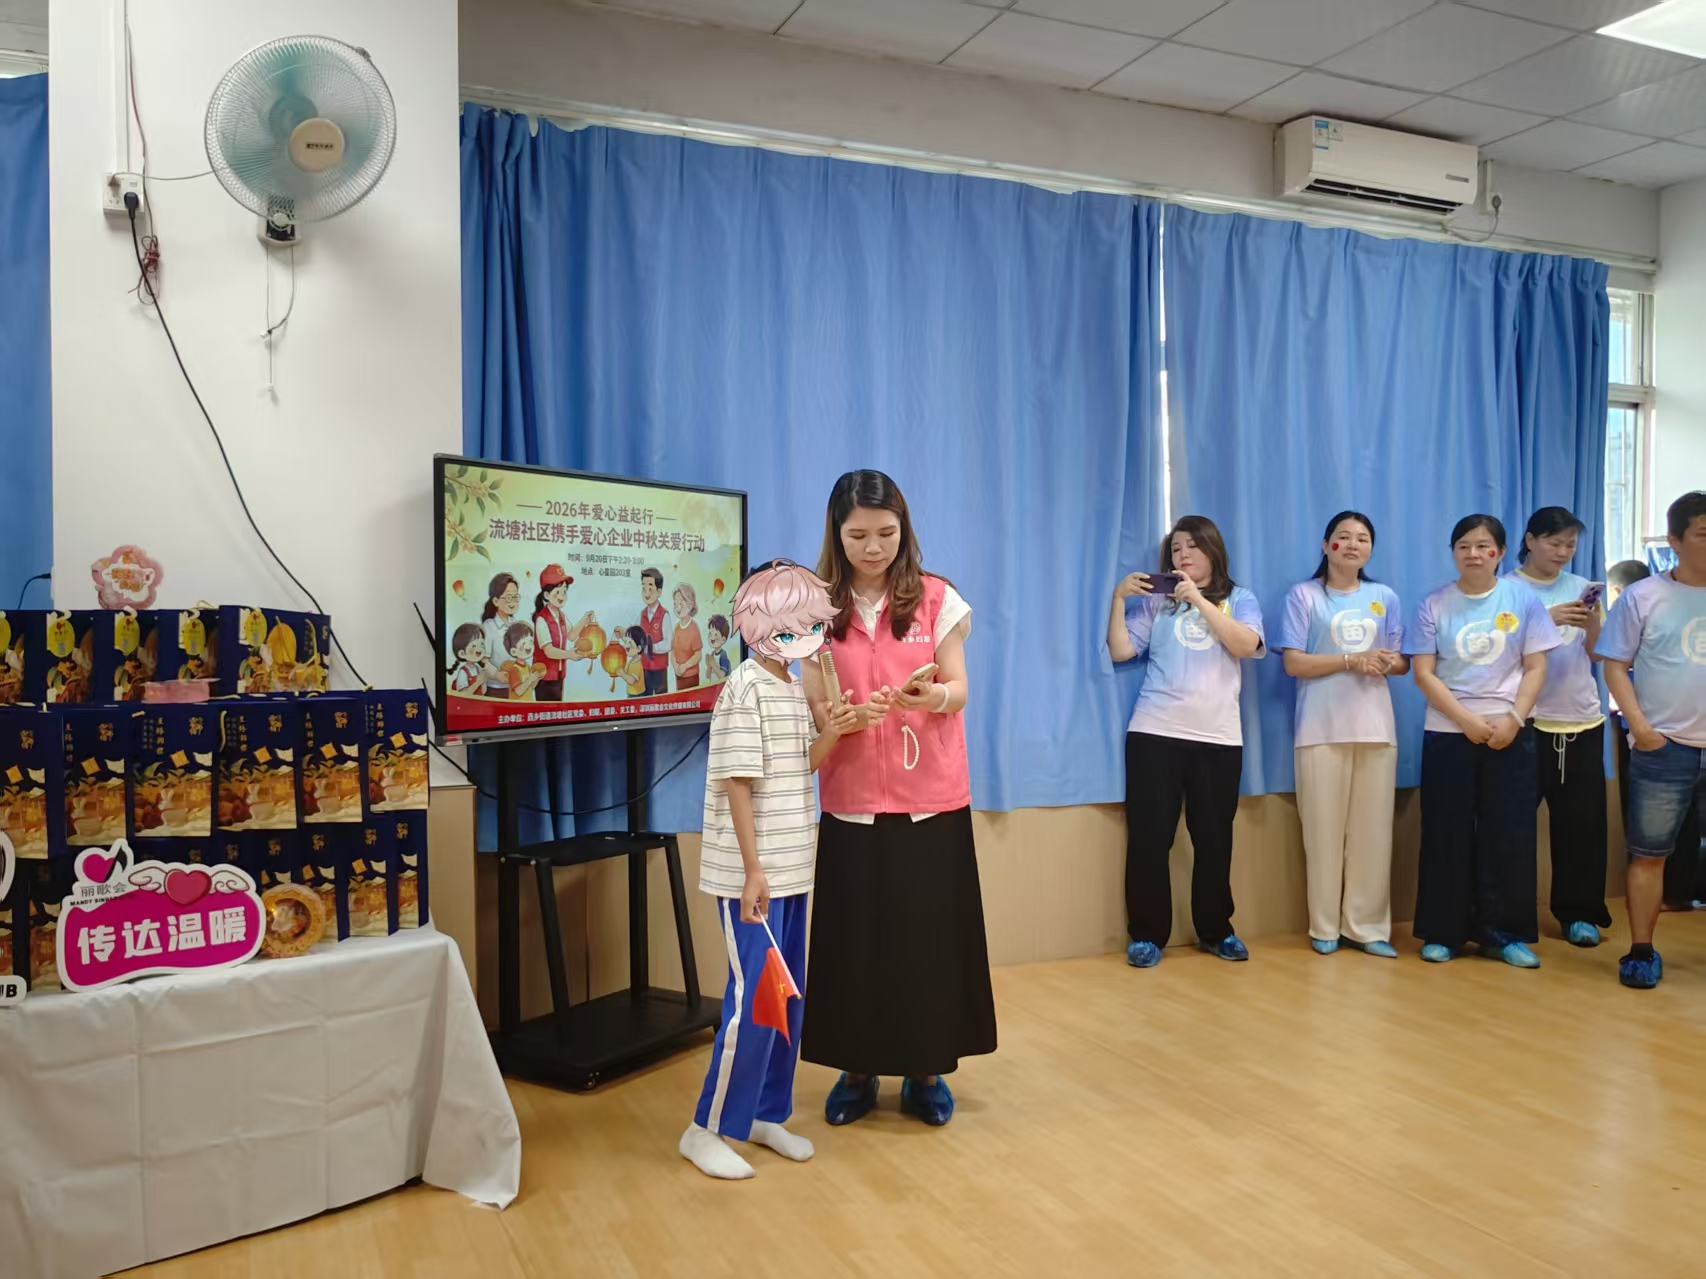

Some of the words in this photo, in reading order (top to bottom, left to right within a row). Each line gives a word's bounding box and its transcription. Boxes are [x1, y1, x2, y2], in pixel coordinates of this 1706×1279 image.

[545, 500, 654, 525] 2026年爱心益起行
[489, 518, 705, 552] 流塘社区携手爱心企业中秋关爱行动
[70, 898, 93, 906] MANDY
[80, 882, 127, 897] 丽歌会
[77, 906, 246, 965] 传达温暖
